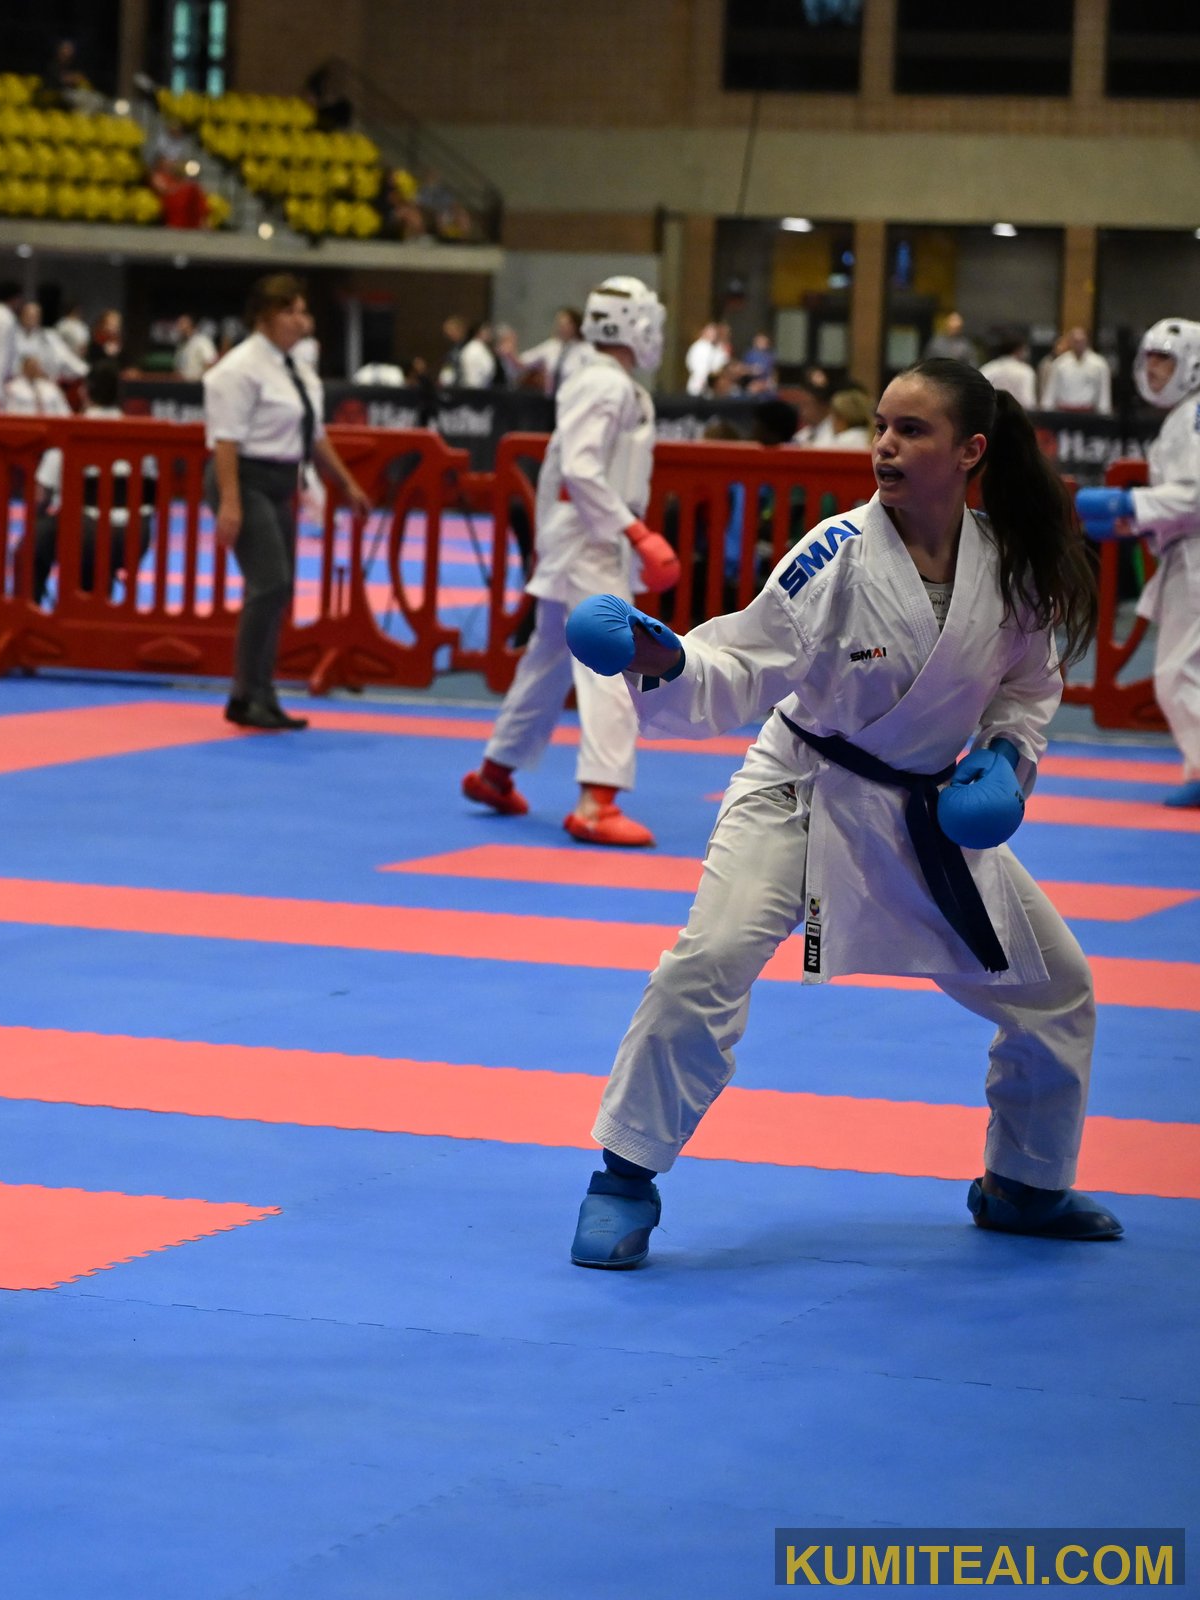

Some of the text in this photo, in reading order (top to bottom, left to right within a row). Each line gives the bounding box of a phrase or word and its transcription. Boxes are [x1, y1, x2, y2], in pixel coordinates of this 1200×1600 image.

[778, 519, 862, 600] SMAI
[850, 647, 887, 662] SMAI
[807, 940, 818, 966] JIN
